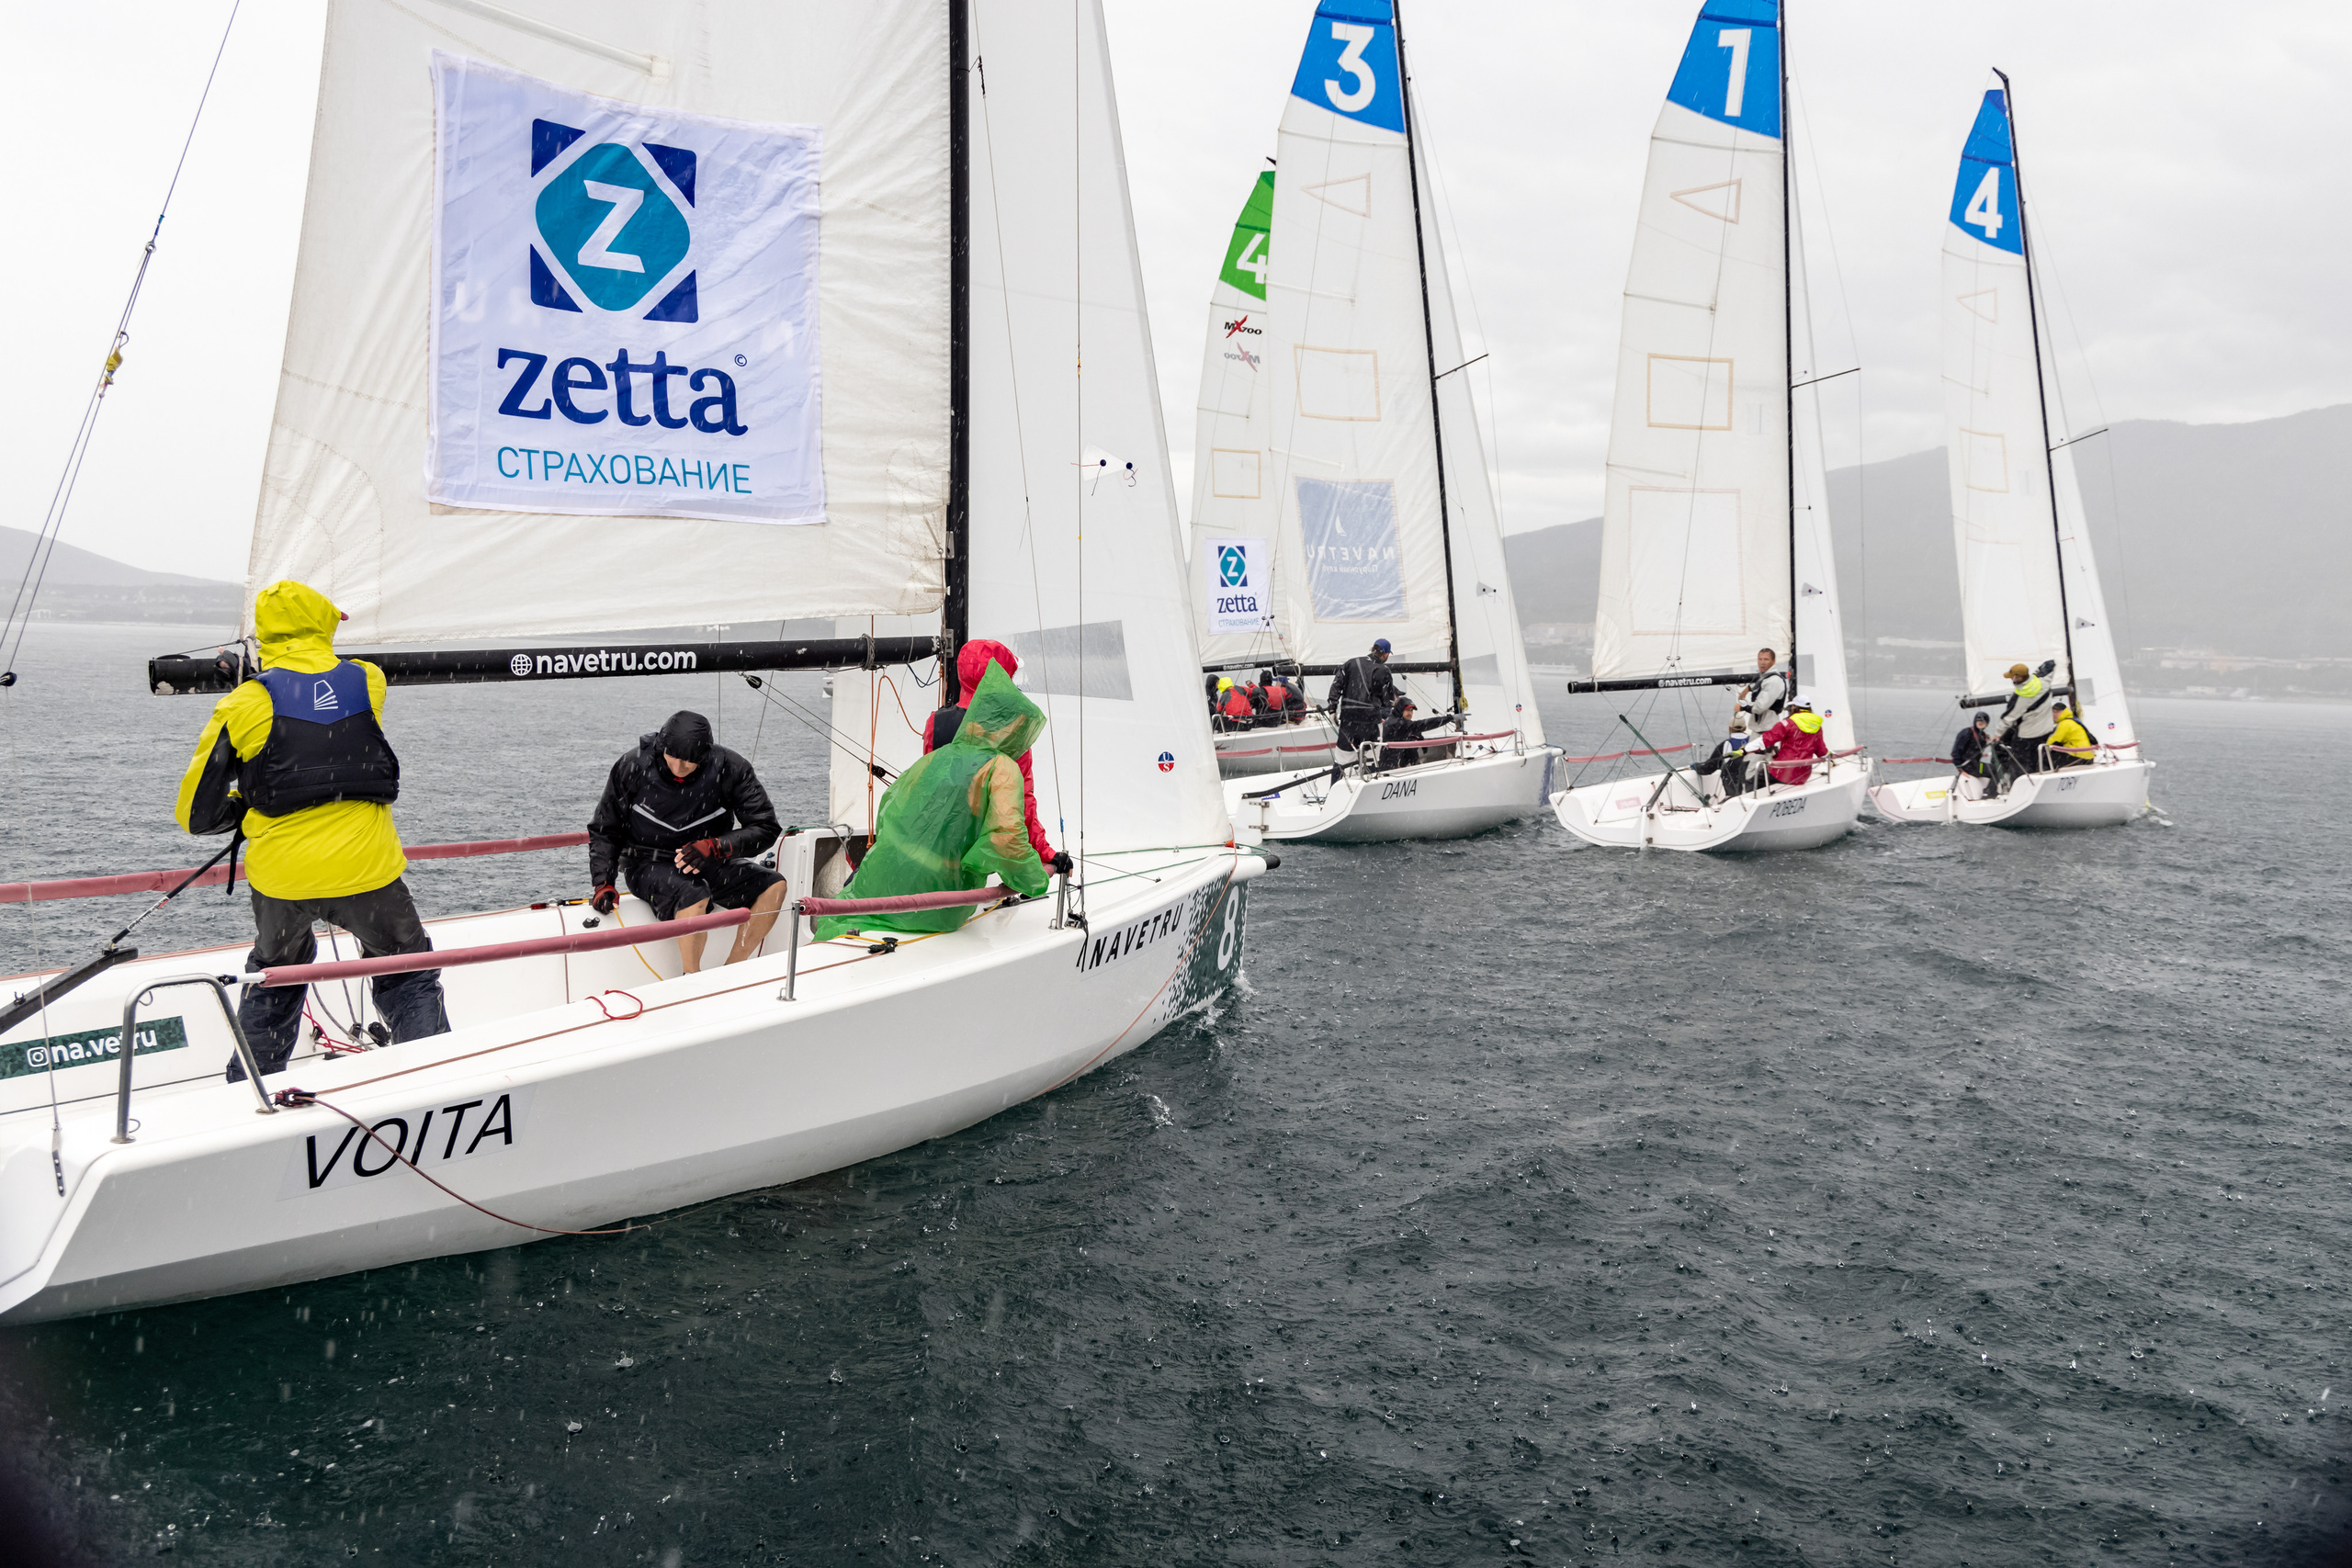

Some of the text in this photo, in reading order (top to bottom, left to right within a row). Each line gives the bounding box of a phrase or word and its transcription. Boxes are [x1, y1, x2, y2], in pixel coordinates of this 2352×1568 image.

[1324, 21, 1376, 113] 3
[1718, 28, 1752, 118] 1
[1964, 167, 2003, 239] 4
[1235, 232, 1268, 285] 4
[1224, 314, 1262, 339] MX700
[498, 347, 749, 436] zetta
[497, 446, 752, 494] СТРАХОВАНИЕ
[1216, 593, 1259, 614] zetta
[1217, 616, 1261, 627] СТРАХОВАНИЕ
[536, 649, 697, 674] navetru.com
[1665, 677, 1713, 687] navetru.com
[1381, 779, 1418, 800] DANA
[1769, 796, 1807, 818] POBEDA
[1089, 903, 1184, 970] NAVETRU
[1217, 885, 1239, 971] 8
[51, 1030, 158, 1064] na.veru
[306, 1093, 513, 1189] VOITA
